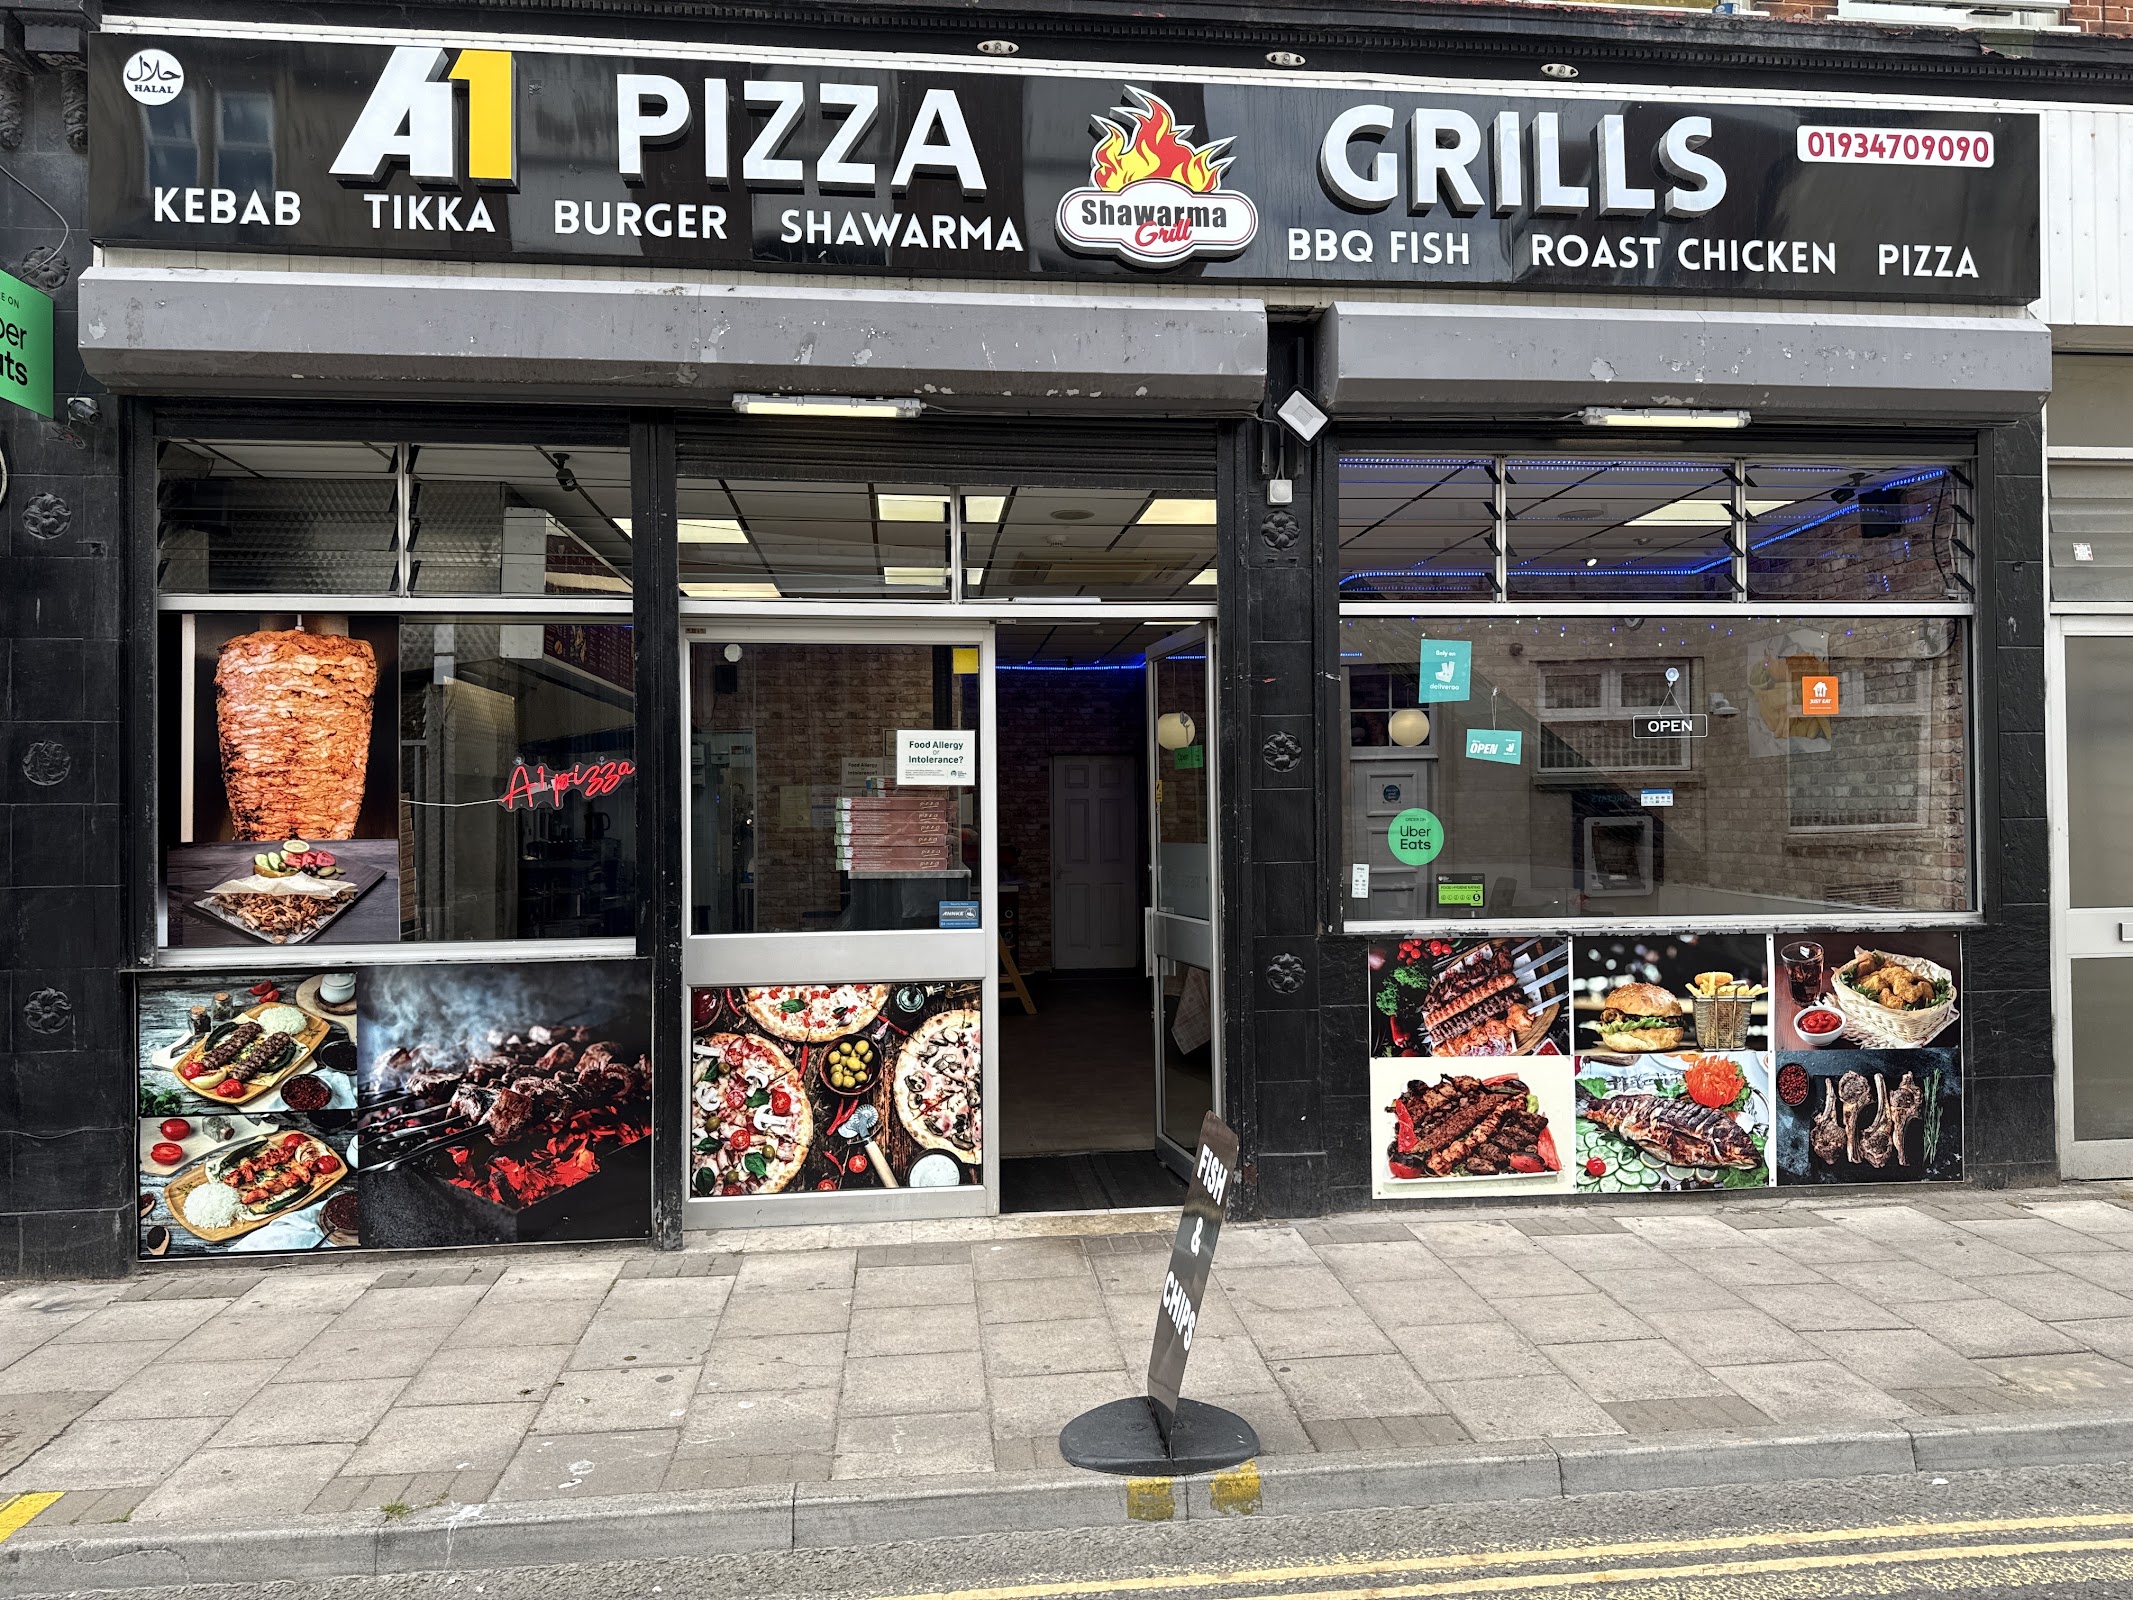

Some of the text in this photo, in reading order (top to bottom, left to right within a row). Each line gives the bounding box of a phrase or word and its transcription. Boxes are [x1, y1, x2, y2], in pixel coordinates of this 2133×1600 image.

[126, 55, 181, 82] حلال
[134, 84, 174, 94] HALAL
[328, 46, 1728, 218] A1 PIZZA GRILLS
[1807, 131, 1989, 163] 01934709090
[154, 186, 1024, 252] KEBAB TIKKA BURGER SHAWARMA
[1081, 199, 1227, 228] Shawarma
[1135, 218, 1193, 247] Grill
[1288, 228, 1979, 279] BBQ FISH ROAST CHICKEN PIZZA
[8, 296, 20, 309] ON
[1429, 683, 1460, 691] deliveroo
[1647, 719, 1693, 733] OPEN
[909, 740, 964, 750] Food Allergy
[1469, 742, 1498, 755] OPEN
[908, 755, 964, 764] Intolerance?
[501, 761, 636, 809] A1 pizza
[1400, 825, 1432, 837] Uber
[1400, 838, 1432, 850] Eats
[1196, 1143, 1228, 1206] FISH
[1190, 1216, 1204, 1257] &
[1162, 1270, 1196, 1351] CHIPS
